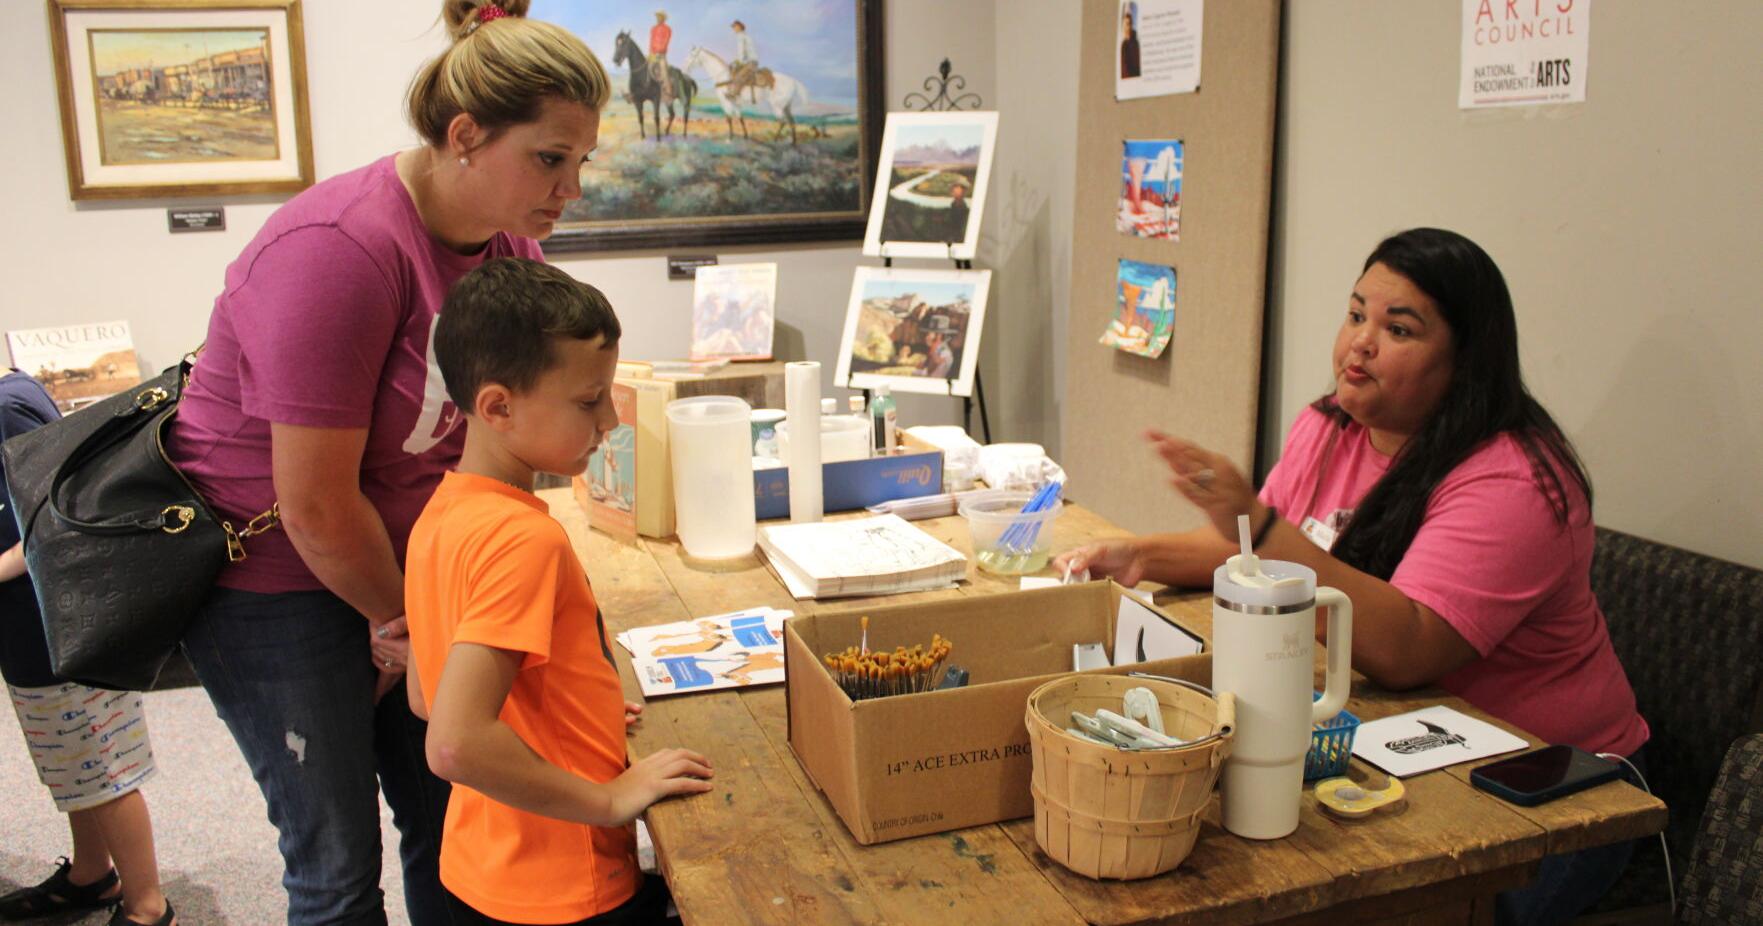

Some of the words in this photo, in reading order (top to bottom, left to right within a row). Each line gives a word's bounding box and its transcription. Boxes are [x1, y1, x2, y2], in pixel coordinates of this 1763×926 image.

[1475, 17, 1574, 46] COUNCIL
[1474, 63, 1516, 78] NATIONAL
[1537, 58, 1571, 88] ARTS
[1474, 76, 1529, 93] ENDOWMENT
[16, 324, 126, 349] VAQUERO
[913, 755, 945, 773] ACE
[949, 747, 1001, 767] EXTRA
